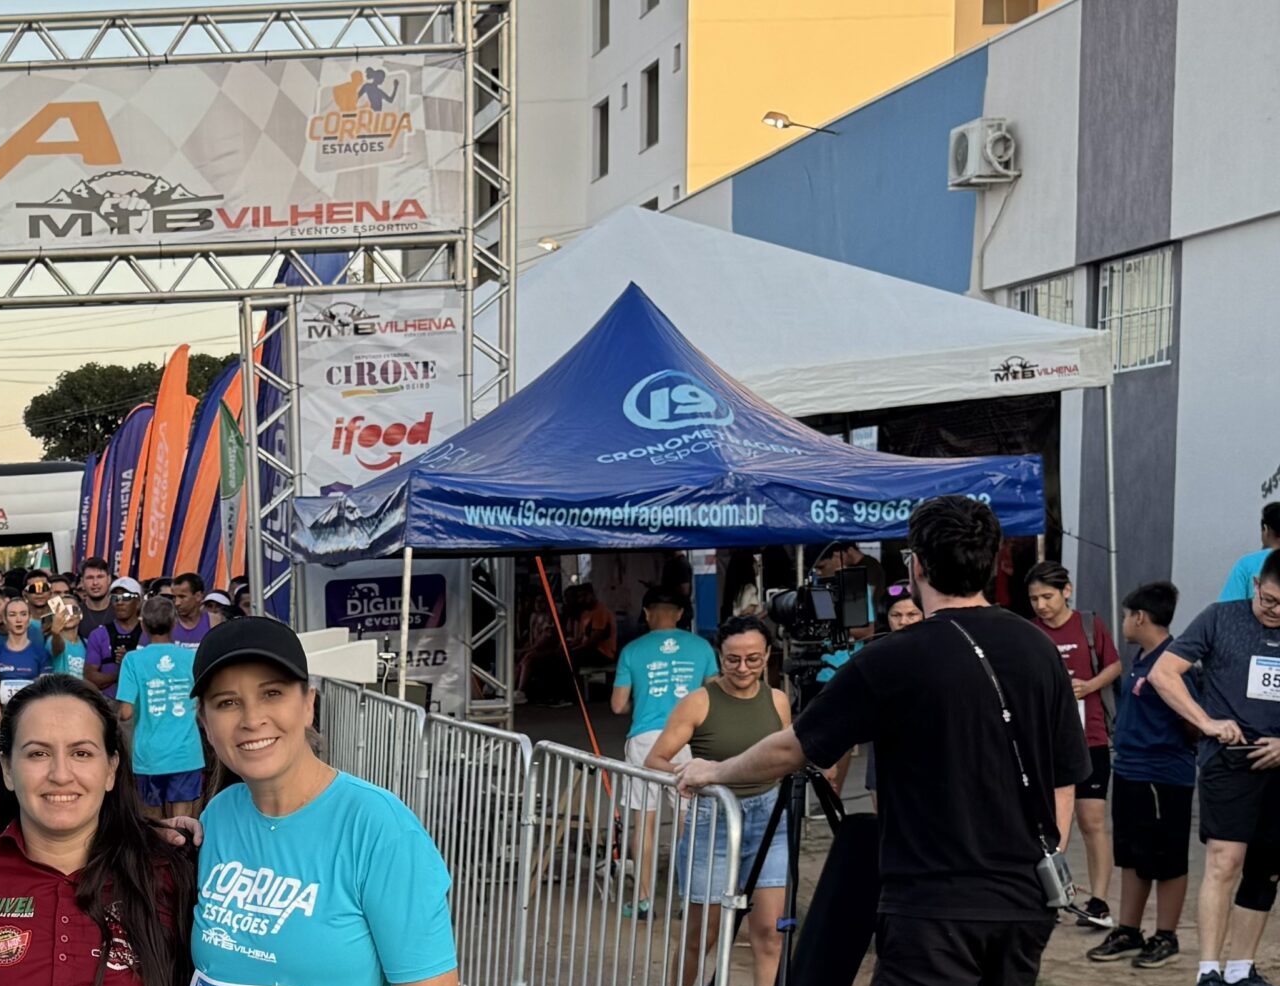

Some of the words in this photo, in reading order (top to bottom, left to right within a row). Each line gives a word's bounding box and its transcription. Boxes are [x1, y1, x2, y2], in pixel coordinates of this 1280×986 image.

[308, 108, 412, 149] CORRIDA
[321, 139, 384, 155] ESTAÇÕES
[290, 225, 347, 238] EVENTOS
[325, 359, 437, 387] CIRONE
[1036, 364, 1079, 376] VILHENA
[331, 411, 434, 456] ifood
[464, 497, 767, 533] www.i9cronometragem.com.br
[810, 498, 846, 524] 65.
[364, 611, 421, 627] evenos
[201, 860, 321, 935] CORRIDA
[202, 902, 271, 936] ESTAÇÕES
